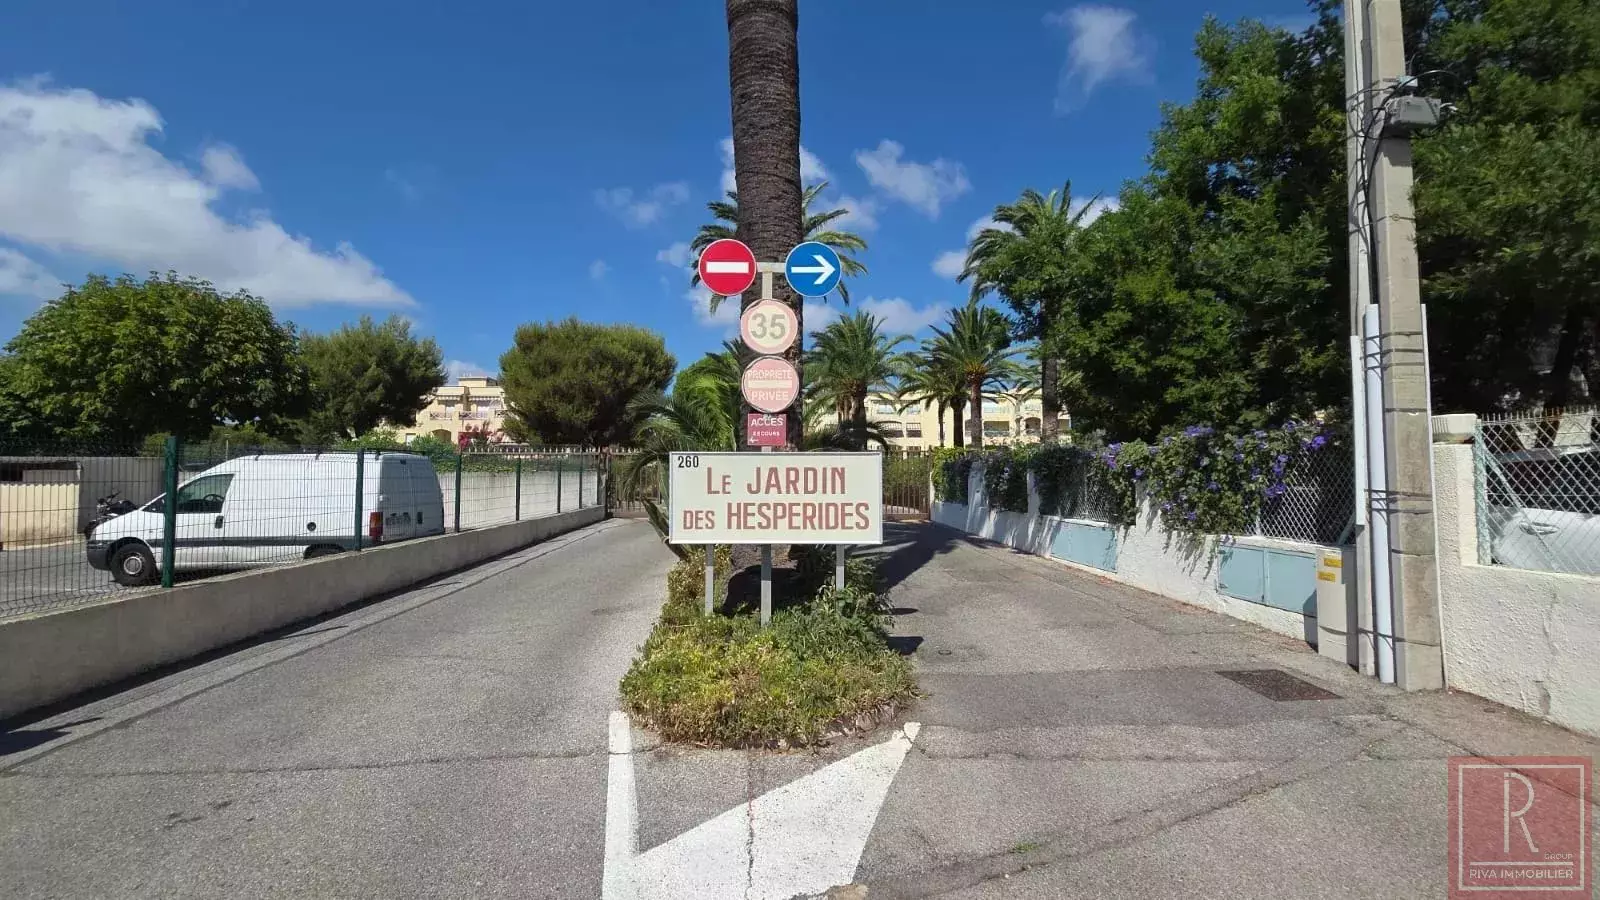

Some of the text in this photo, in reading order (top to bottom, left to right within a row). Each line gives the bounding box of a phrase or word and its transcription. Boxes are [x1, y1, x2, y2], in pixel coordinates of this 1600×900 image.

[751, 312, 786, 340] 35
[677, 455, 699, 468] 260
[747, 466, 846, 495] JARDIN
[683, 502, 870, 530] DES HESPERIDES
